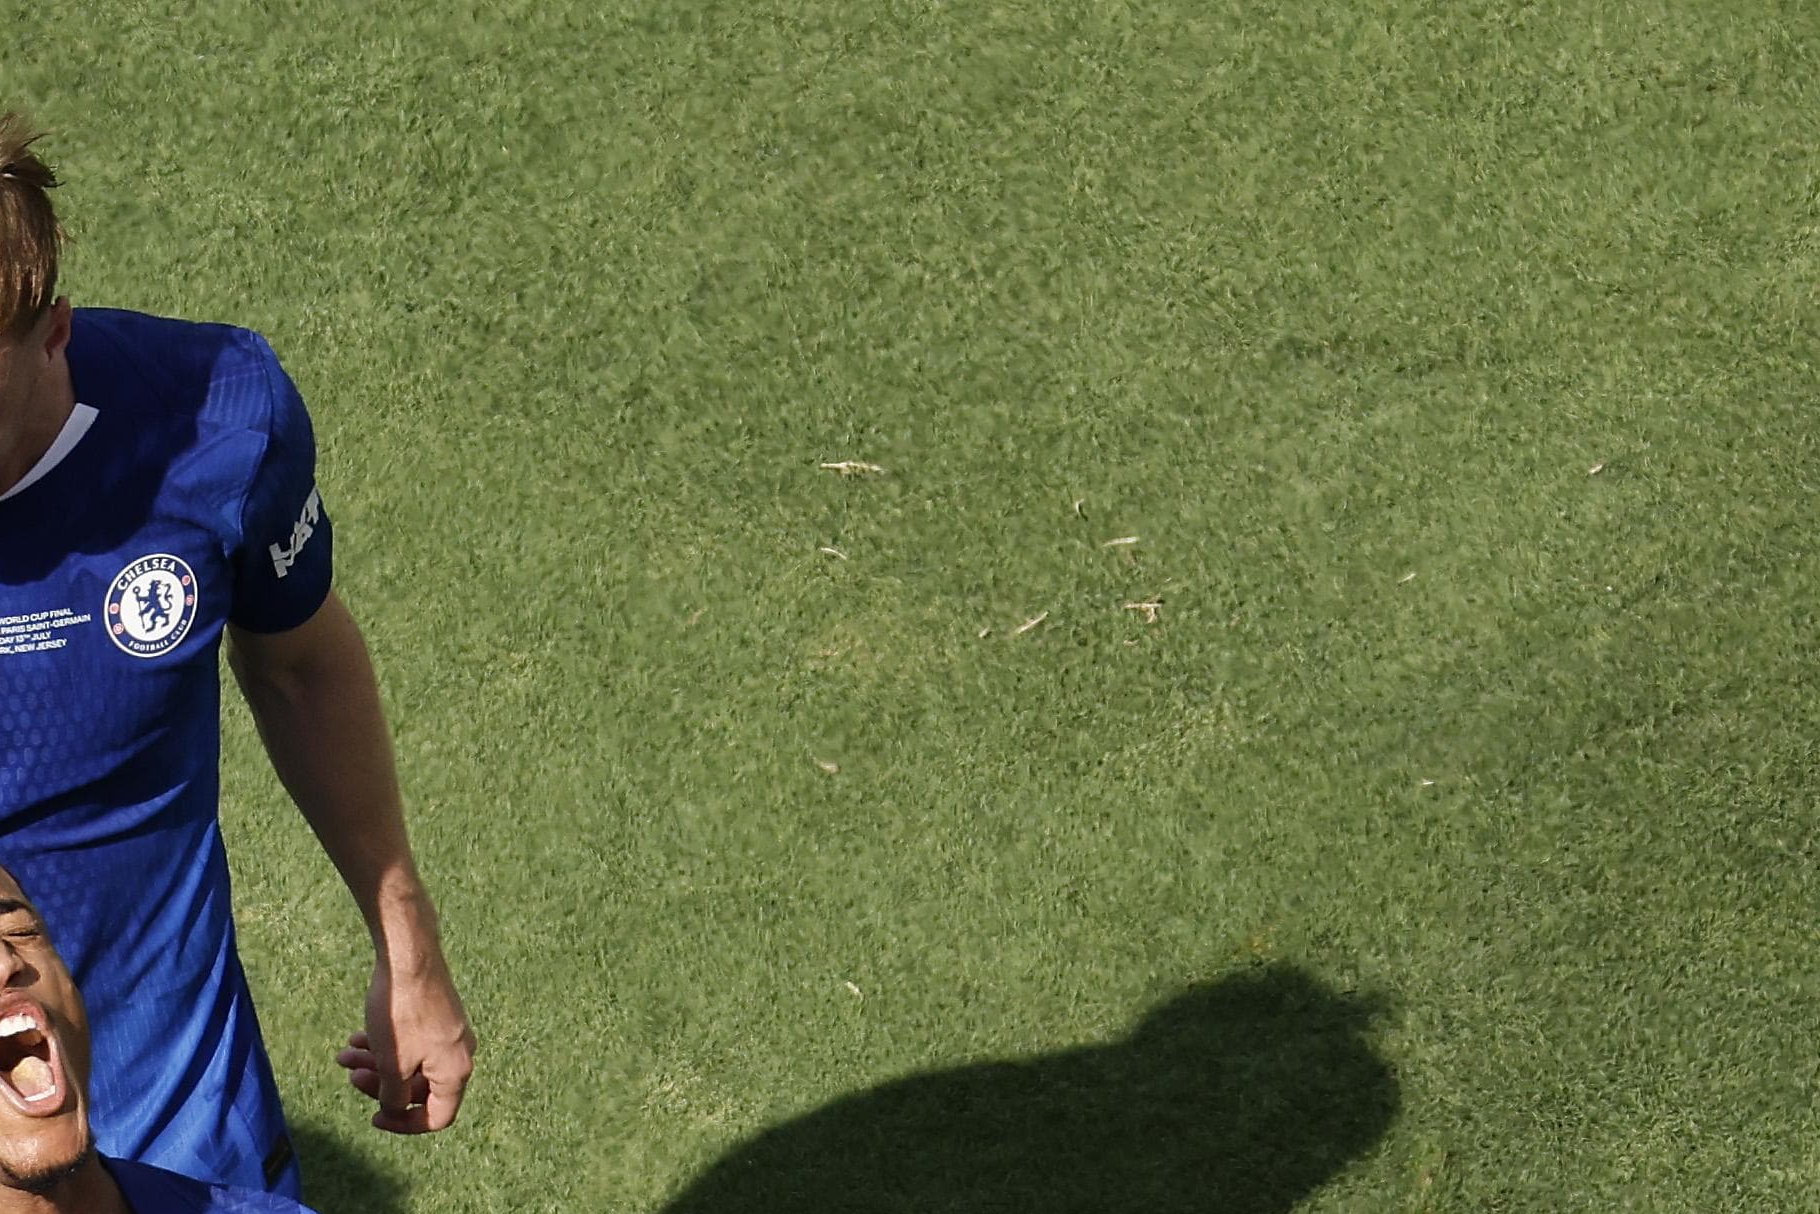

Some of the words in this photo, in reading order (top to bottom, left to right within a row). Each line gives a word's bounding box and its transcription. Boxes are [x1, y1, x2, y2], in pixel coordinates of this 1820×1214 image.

[117, 558, 176, 590] CHELSEA
[30, 612, 49, 622] CUP
[50, 608, 74, 618] FINAL
[1, 626, 26, 635] PARIS
[26, 614, 91, 632] SAINT-GERMAIN
[31, 632, 52, 640] JULY
[128, 640, 169, 651] FOOTBALL
[171, 619, 188, 640] CLUB
[15, 643, 36, 652] NEW
[36, 638, 68, 650] JERSEY
